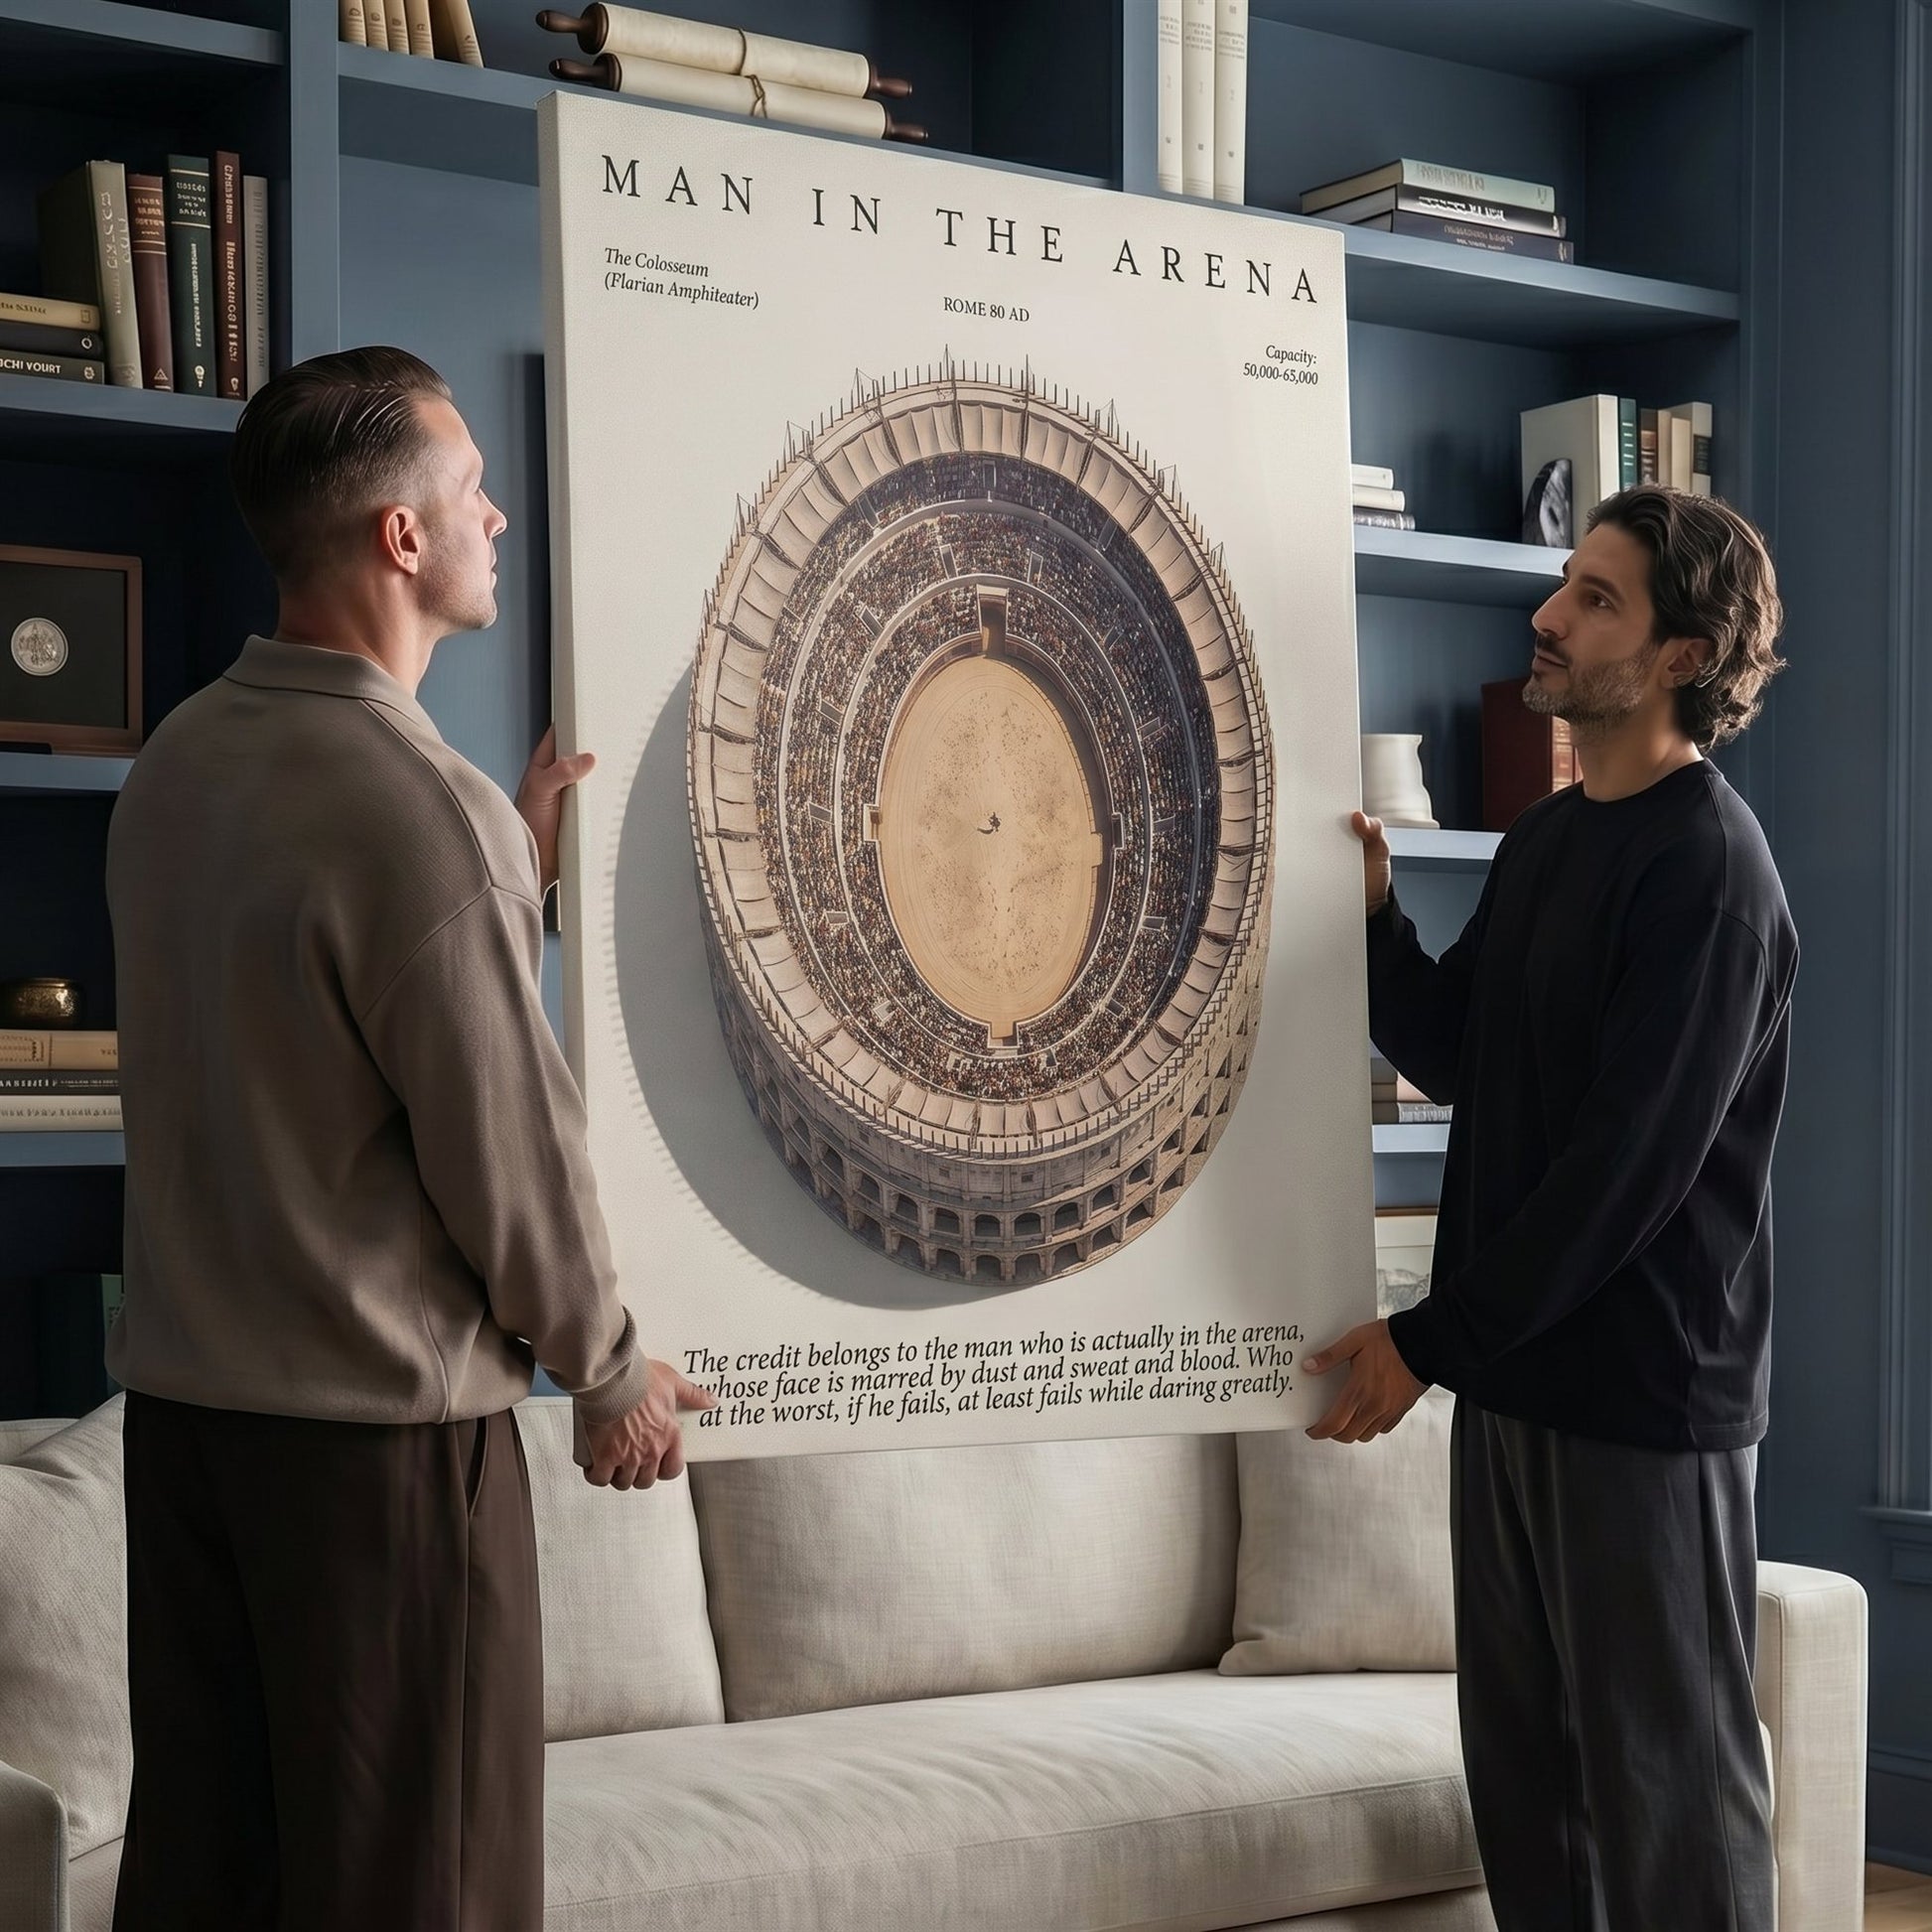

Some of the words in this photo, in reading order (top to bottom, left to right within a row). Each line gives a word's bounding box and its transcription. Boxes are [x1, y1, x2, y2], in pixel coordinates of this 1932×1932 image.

[601, 154, 754, 215] MAN
[811, 188, 882, 235] IN
[935, 207, 1063, 263] THE
[1112, 238, 1318, 304] ARENA
[604, 247, 632, 267] The
[634, 252, 709, 278] Colosseum
[604, 271, 664, 295] (Flarian
[667, 281, 759, 311] Amphiteater)
[943, 296, 987, 317] ROME
[989, 304, 1006, 320] 80
[1009, 307, 1031, 323] AD
[26, 361, 62, 374] VOURT
[1242, 362, 1319, 386] 50,000-65,000
[1265, 345, 1317, 368] Capacity:
[684, 1348, 729, 1374] The
[736, 1344, 801, 1371] credit
[808, 1341, 891, 1371] belongs
[897, 1341, 917, 1362] to
[924, 1336, 958, 1360] the
[964, 1340, 1013, 1358] man
[1019, 1330, 1063, 1354] who
[1070, 1330, 1086, 1352] is
[1092, 1324, 1173, 1354] actually
[1179, 1325, 1199, 1345] in
[1206, 1321, 1237, 1344] the
[1242, 1324, 1305, 1342] arena,
[770, 1371, 820, 1403] face
[827, 1370, 844, 1393] is
[852, 1363, 934, 1391] marred
[941, 1362, 966, 1393] by
[971, 1360, 1018, 1384] dust
[1024, 1356, 1064, 1380] and
[1069, 1356, 1129, 1378] sweat
[1135, 1350, 1173, 1375] and
[1180, 1346, 1240, 1372] blood.
[1247, 1344, 1294, 1367] Who
[699, 1405, 723, 1428] at
[730, 1401, 765, 1426] the
[771, 1399, 840, 1423] worst,
[847, 1393, 867, 1426] if
[869, 1393, 895, 1417] he
[896, 1389, 950, 1423] fails,
[958, 1390, 980, 1412] at
[985, 1386, 1035, 1410] least
[1035, 1381, 1082, 1414] fails
[1088, 1377, 1144, 1403] while
[1149, 1376, 1217, 1403] daring
[1219, 1369, 1294, 1403] greatly.
